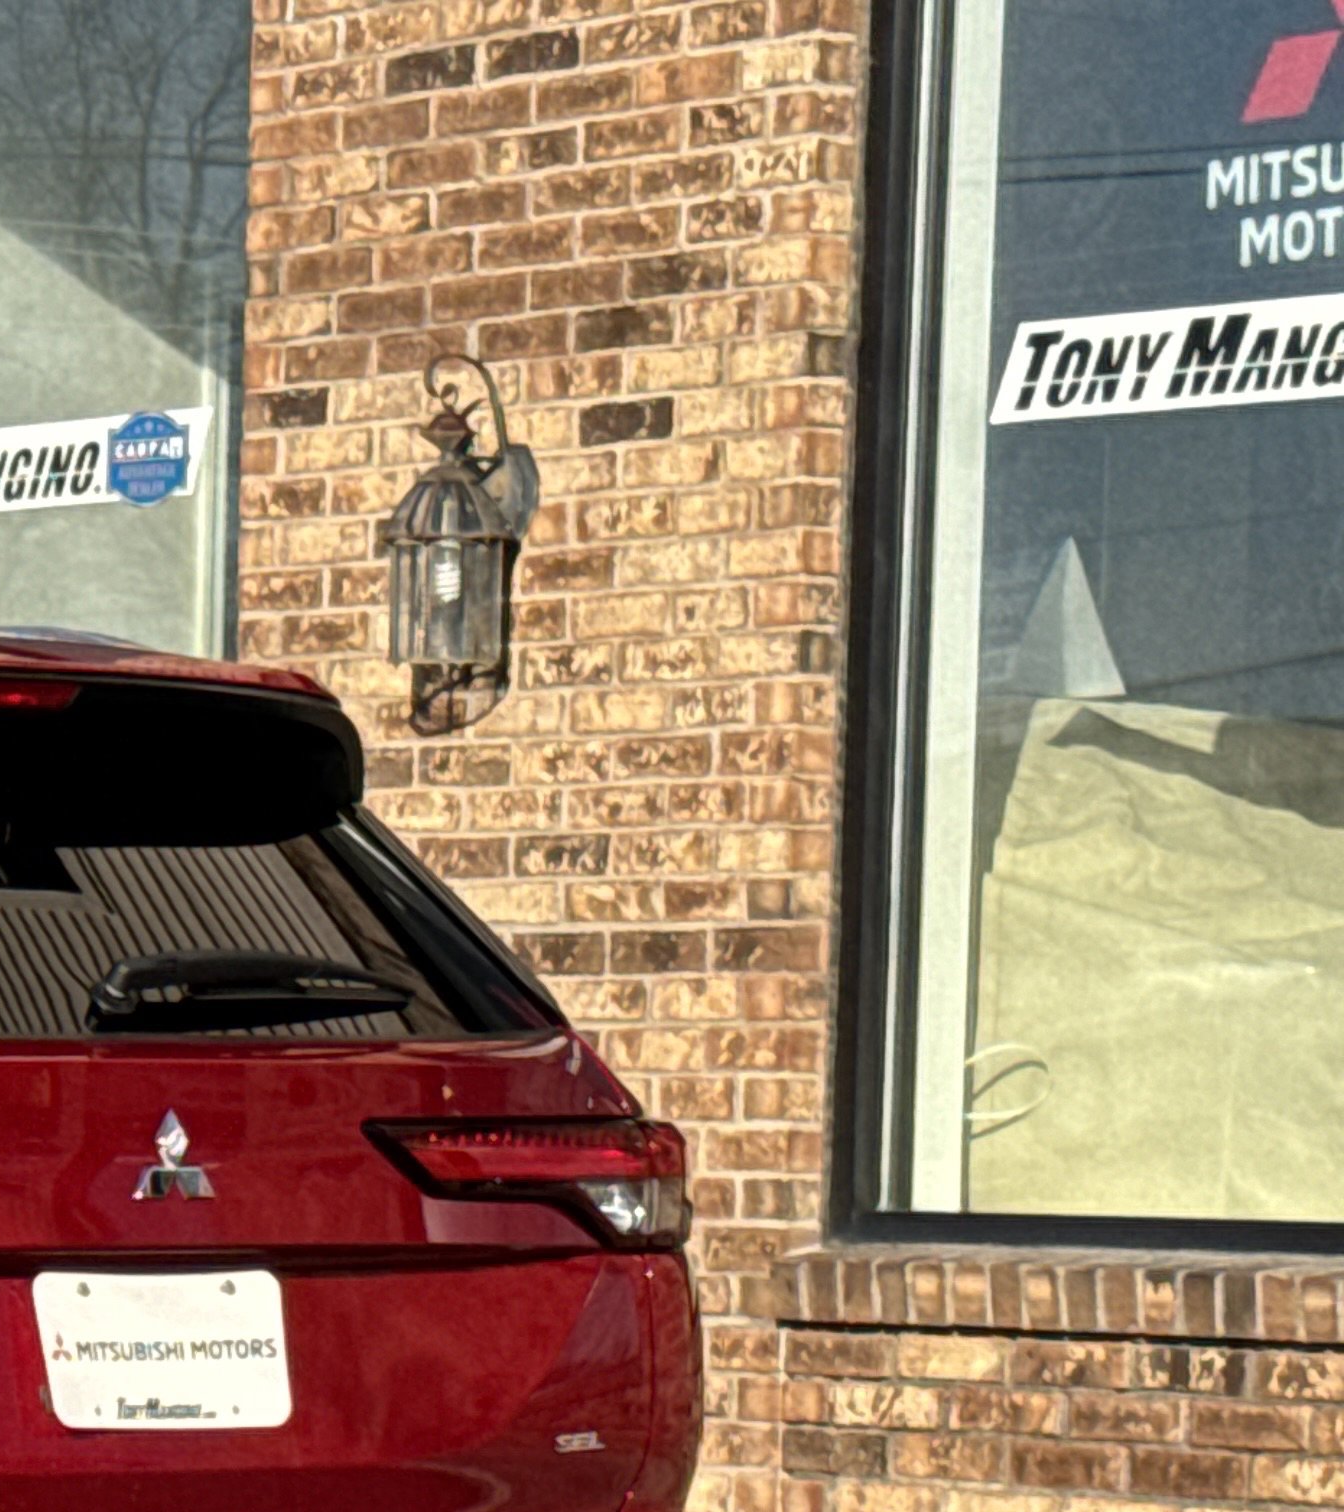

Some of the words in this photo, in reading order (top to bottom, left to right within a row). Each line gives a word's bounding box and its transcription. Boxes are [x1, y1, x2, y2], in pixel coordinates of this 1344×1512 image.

[1239, 206, 1344, 268] MOT
[1015, 331, 1173, 410] TONY
[75, 1340, 185, 1361] MITSUBISHI
[190, 1338, 277, 1359] MOTORS
